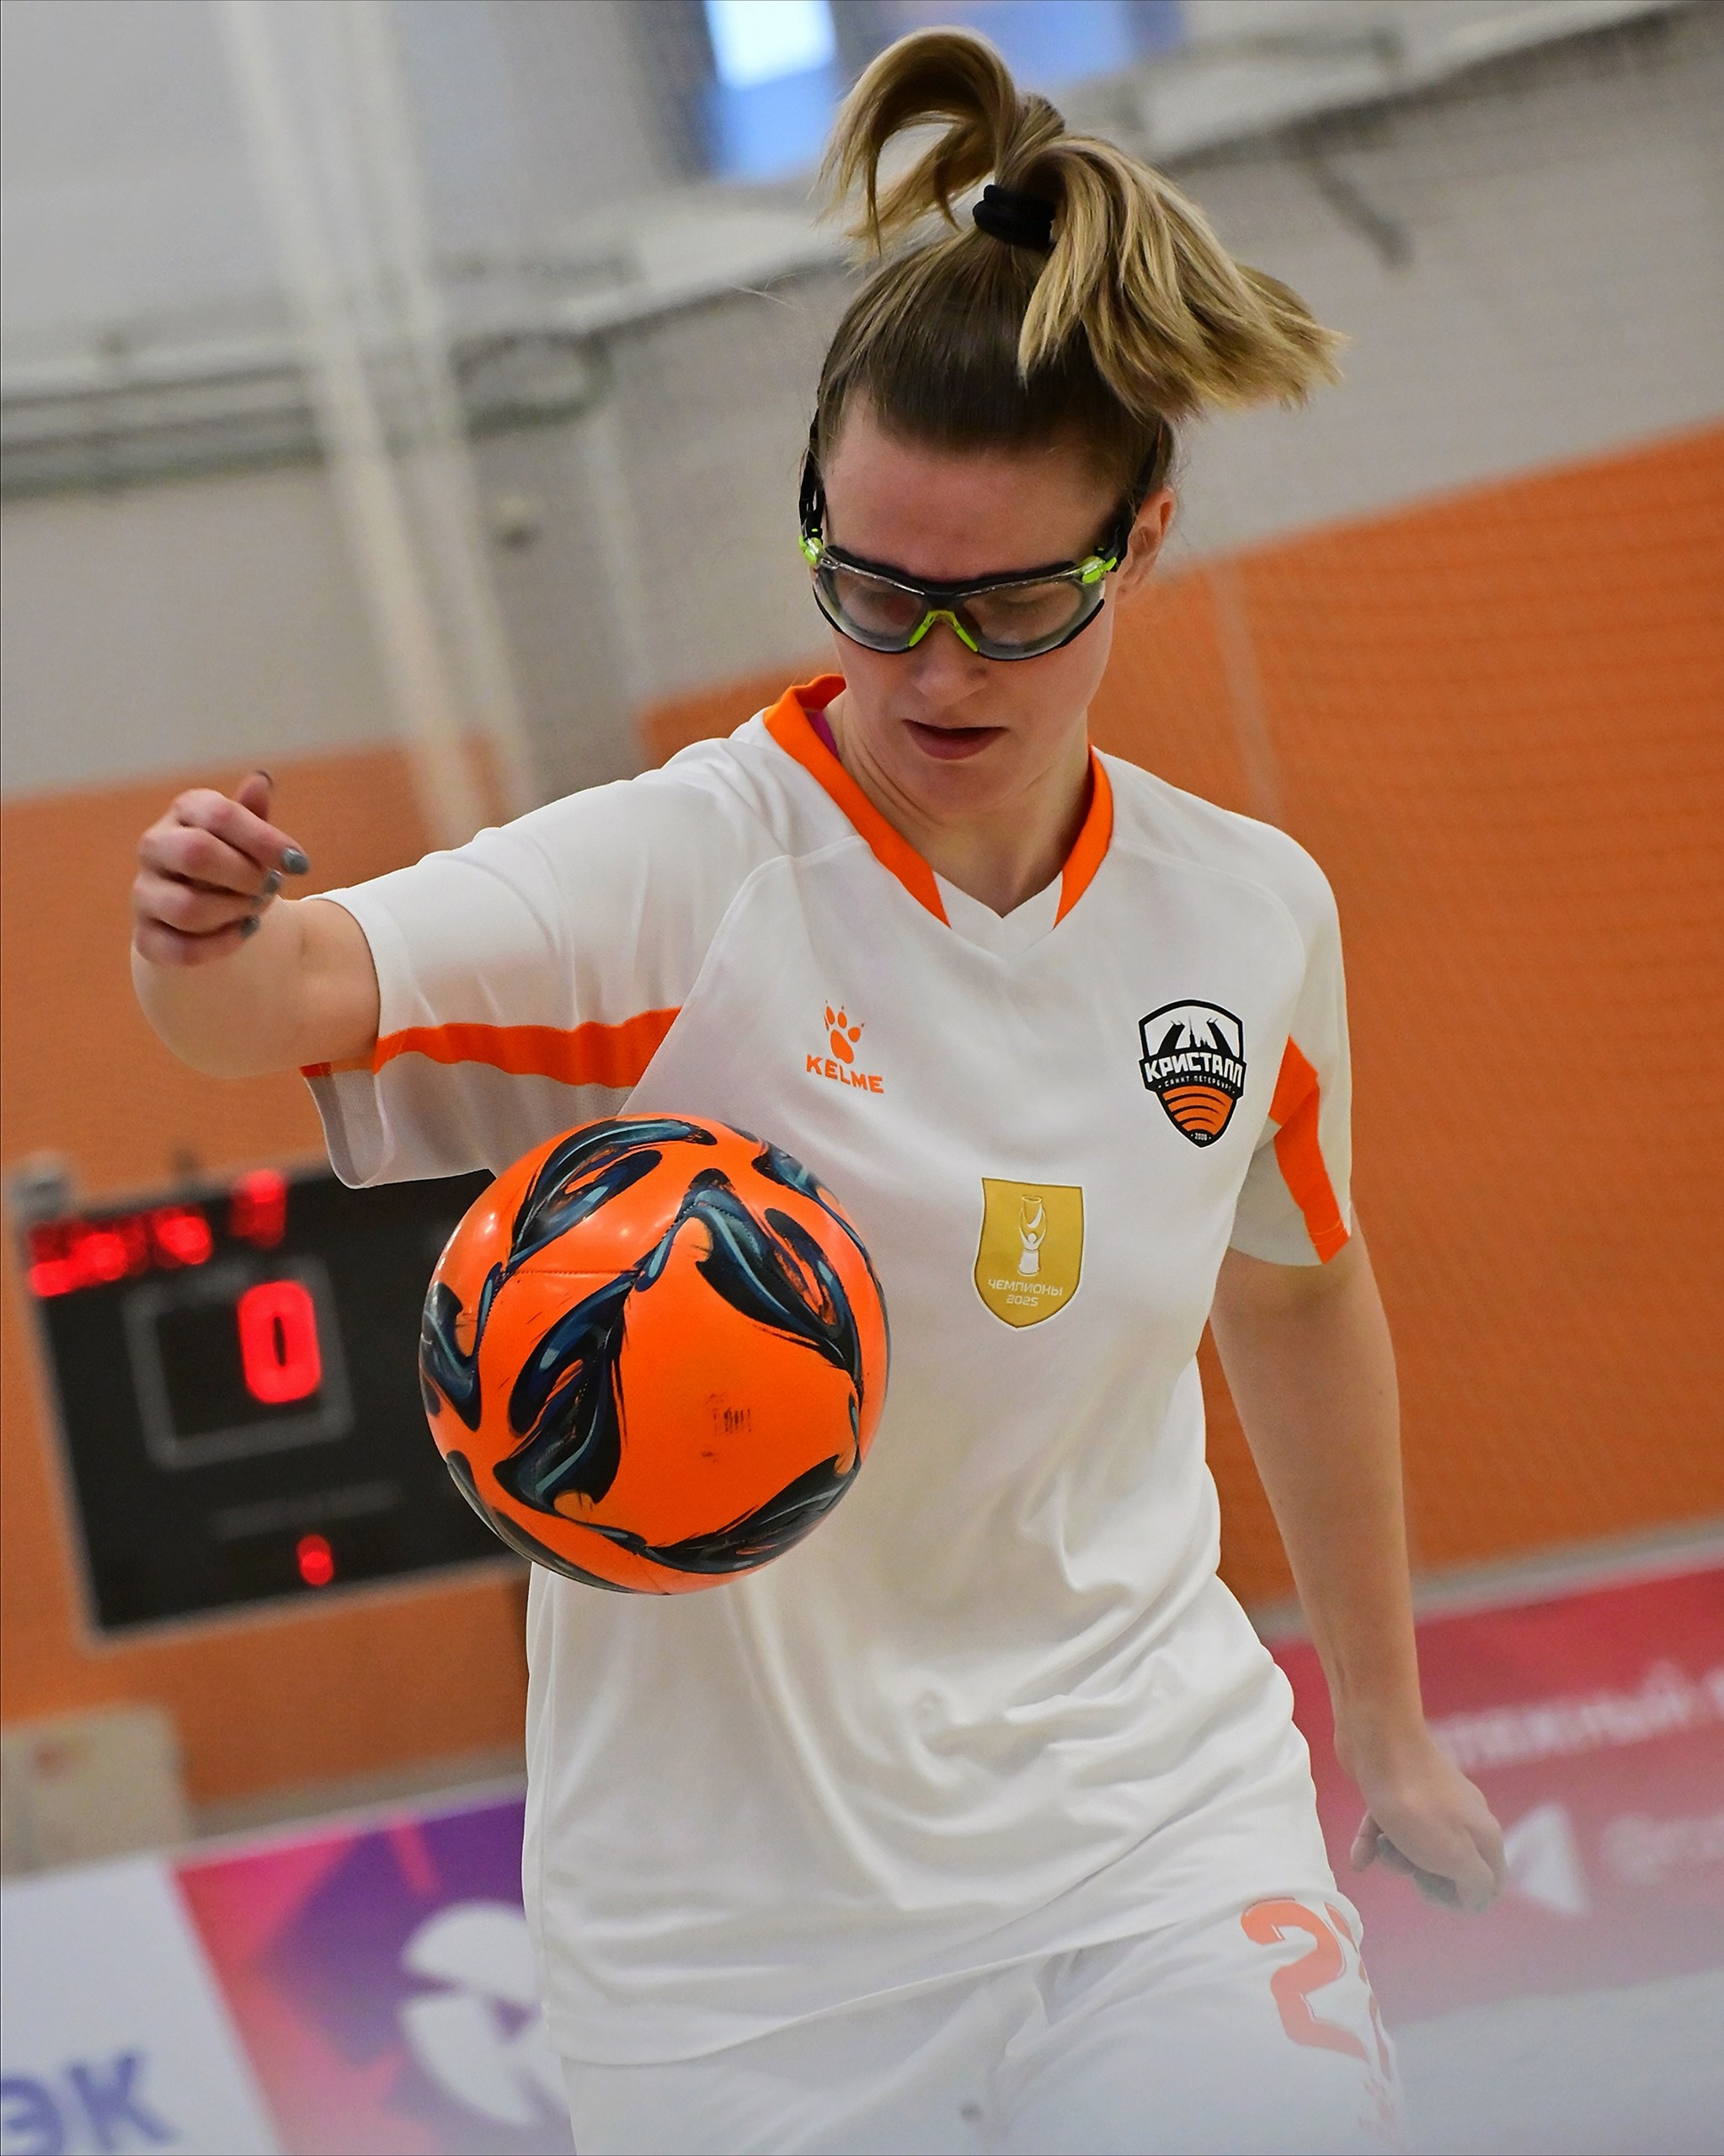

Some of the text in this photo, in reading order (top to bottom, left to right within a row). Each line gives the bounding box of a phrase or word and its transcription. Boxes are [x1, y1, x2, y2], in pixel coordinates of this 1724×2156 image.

[806, 1054, 884, 1094] KELME
[1145, 1052, 1243, 1088] КРИСТАЛЛ
[987, 1278, 1063, 1296] ЧЕМПИОНЫ
[1006, 1294, 1038, 1307] 2025
[238, 1280, 322, 1404] 0
